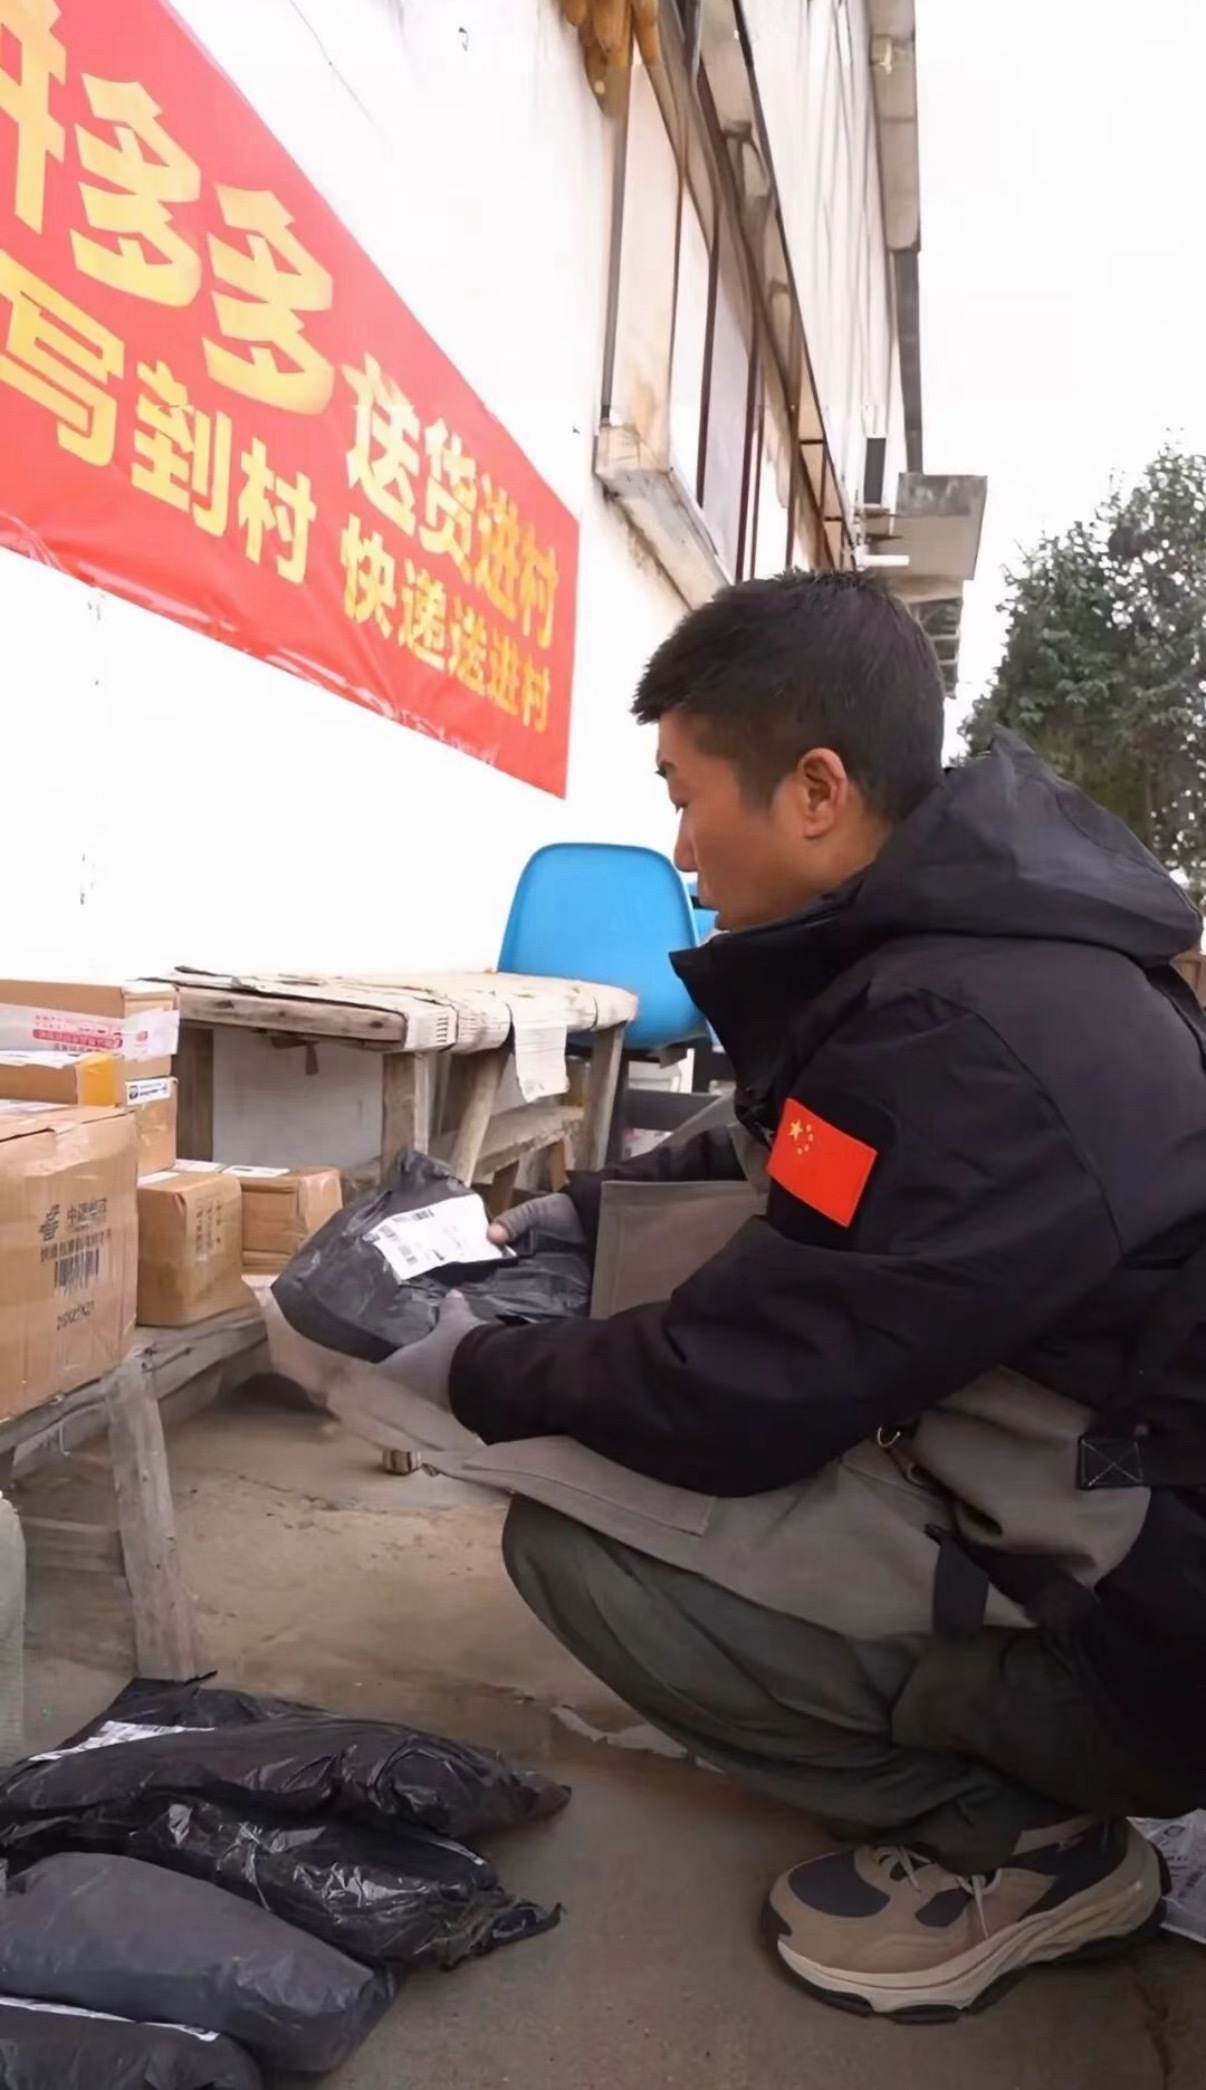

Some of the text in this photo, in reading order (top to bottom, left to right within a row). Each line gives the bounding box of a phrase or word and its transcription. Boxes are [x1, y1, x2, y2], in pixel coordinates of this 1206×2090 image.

[0, 248, 317, 585] 写到村
[341, 352, 559, 650] 送货进村
[340, 512, 550, 733] 快递送进村
